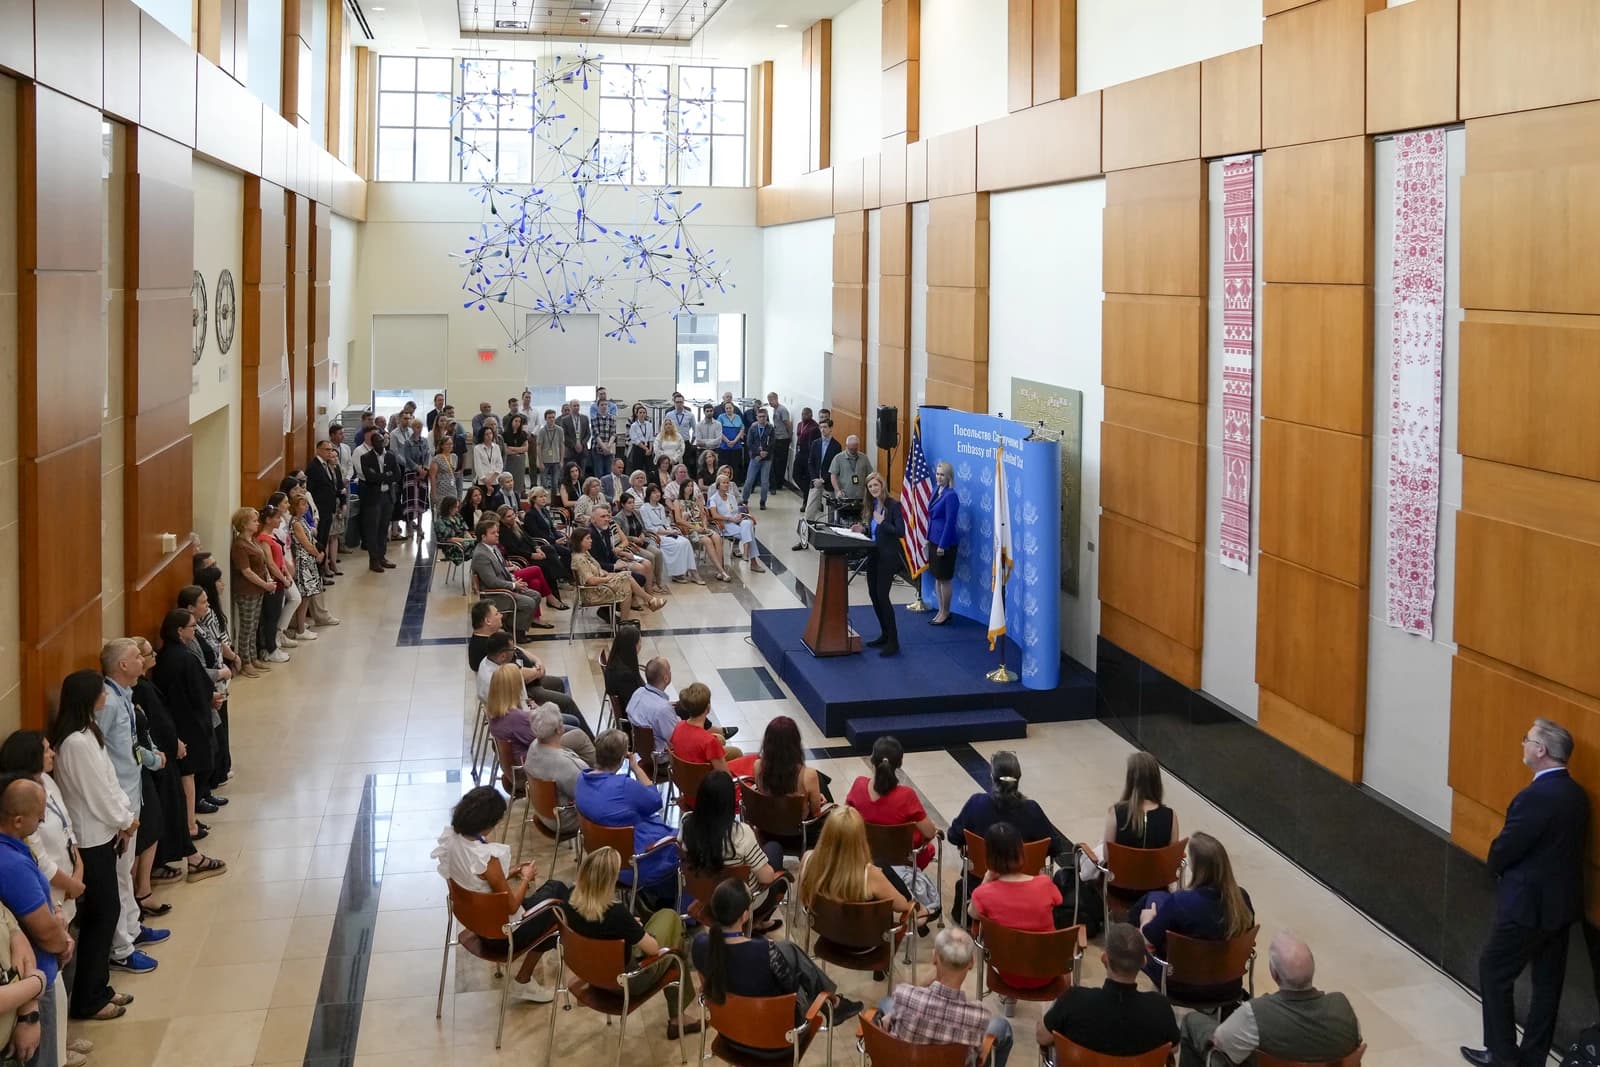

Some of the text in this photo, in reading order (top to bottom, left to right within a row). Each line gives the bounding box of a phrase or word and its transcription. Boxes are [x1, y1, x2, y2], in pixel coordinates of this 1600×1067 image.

[953, 424, 991, 440] Посольство
[957, 441, 984, 458] Embassy
[986, 447, 992, 458] of
